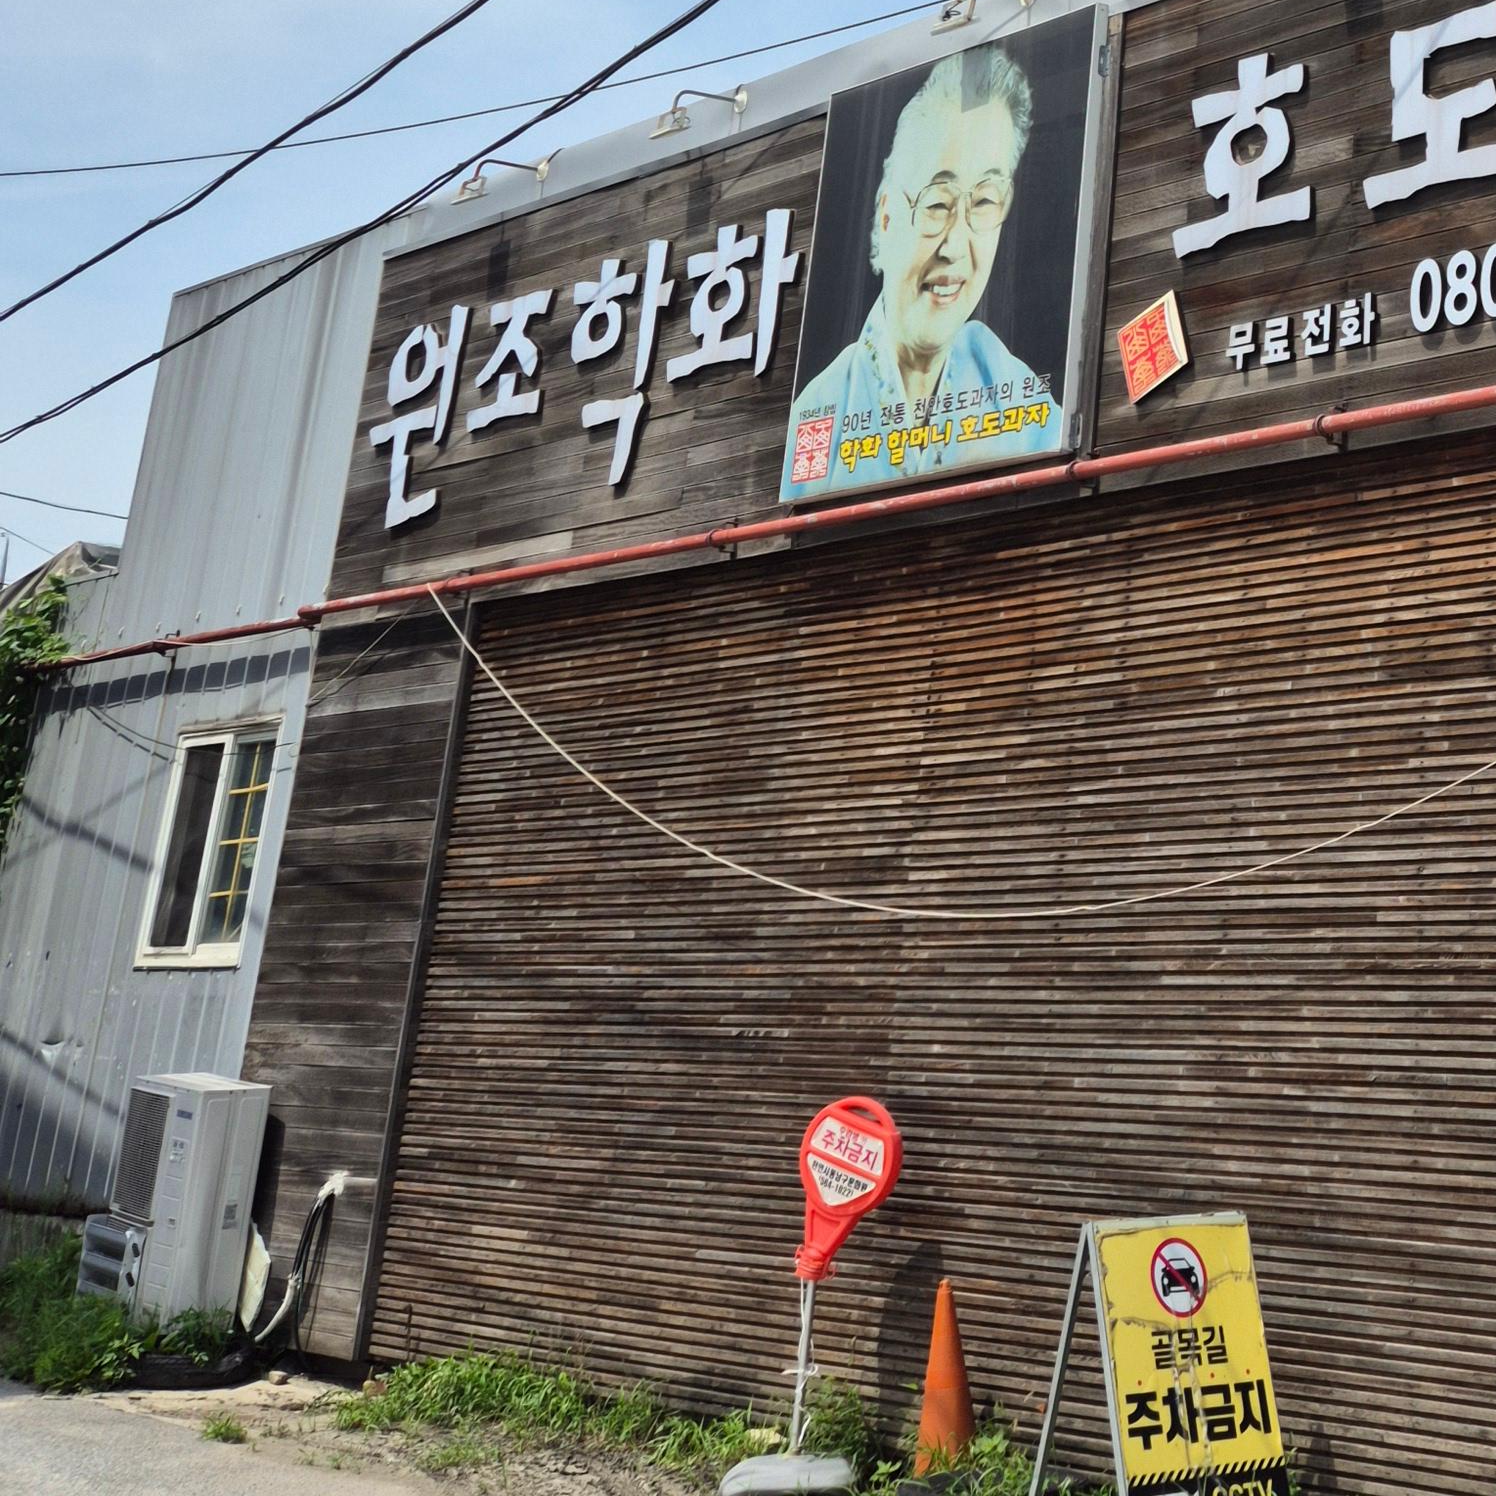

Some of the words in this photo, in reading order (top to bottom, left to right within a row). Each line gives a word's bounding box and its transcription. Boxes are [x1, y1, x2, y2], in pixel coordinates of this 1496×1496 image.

[841, 408, 872, 434] 90년
[880, 401, 906, 427] 전통
[912, 380, 1014, 421] 천안호도과자의
[1022, 373, 1052, 399] 원조
[839, 433, 882, 474] 학화
[887, 418, 951, 466] 할머니
[956, 401, 1051, 442] 호도과자
[821, 1129, 879, 1171] 주차금지
[1151, 1325, 1228, 1370] 골목길
[1125, 1379, 1272, 1450] 주차금지
